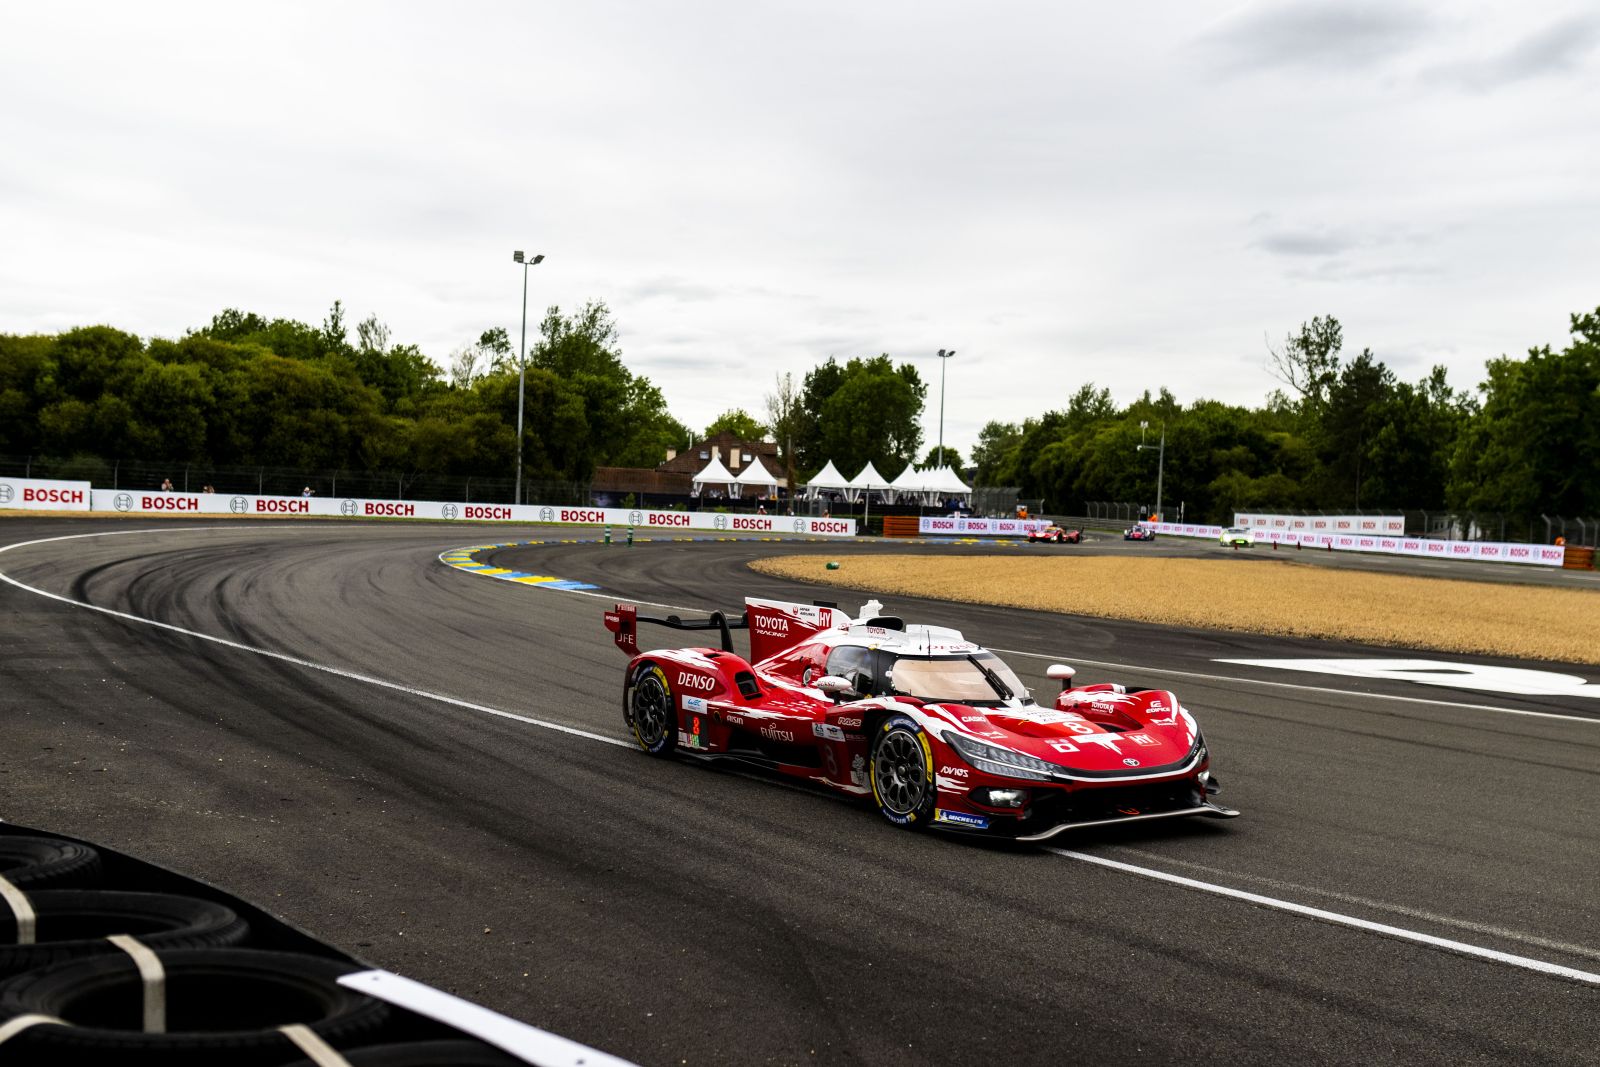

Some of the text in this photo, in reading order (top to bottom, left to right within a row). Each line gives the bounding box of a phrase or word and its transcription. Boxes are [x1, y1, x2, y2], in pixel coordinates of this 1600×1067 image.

[23, 488, 83, 503] BOSCH
[142, 497, 199, 510] BOSCH
[256, 499, 309, 513] BOSCH
[365, 503, 415, 516] BOSCH
[465, 506, 511, 519] BOSCH
[561, 510, 604, 523] BOSCH
[649, 514, 690, 526] BOSCH
[733, 518, 772, 530] BOSCH
[932, 521, 954, 529] BOSCH
[967, 522, 988, 530] BOSCH
[811, 521, 848, 533] BOSCH
[1428, 543, 1443, 552] BOSCH
[1453, 544, 1470, 553] BOSCH
[1481, 546, 1498, 555] BOSCH
[1510, 548, 1529, 557] BOSCH
[1541, 549, 1561, 560] BOSCH
[755, 615, 788, 631] TOYOTA
[820, 611, 831, 627] HY
[755, 629, 788, 638] RACING
[867, 626, 886, 635] TOYOTA
[618, 633, 634, 645] JFE
[678, 671, 716, 691] DENSO
[687, 698, 702, 706] WEC
[1091, 701, 1109, 709] TOYOTA
[693, 717, 700, 735] 8
[1062, 721, 1094, 734] 8
[760, 723, 794, 742] FUJITSU
[1130, 734, 1154, 744] HY
[941, 765, 969, 778] ADVICS
[949, 814, 984, 825] MICHELIN
